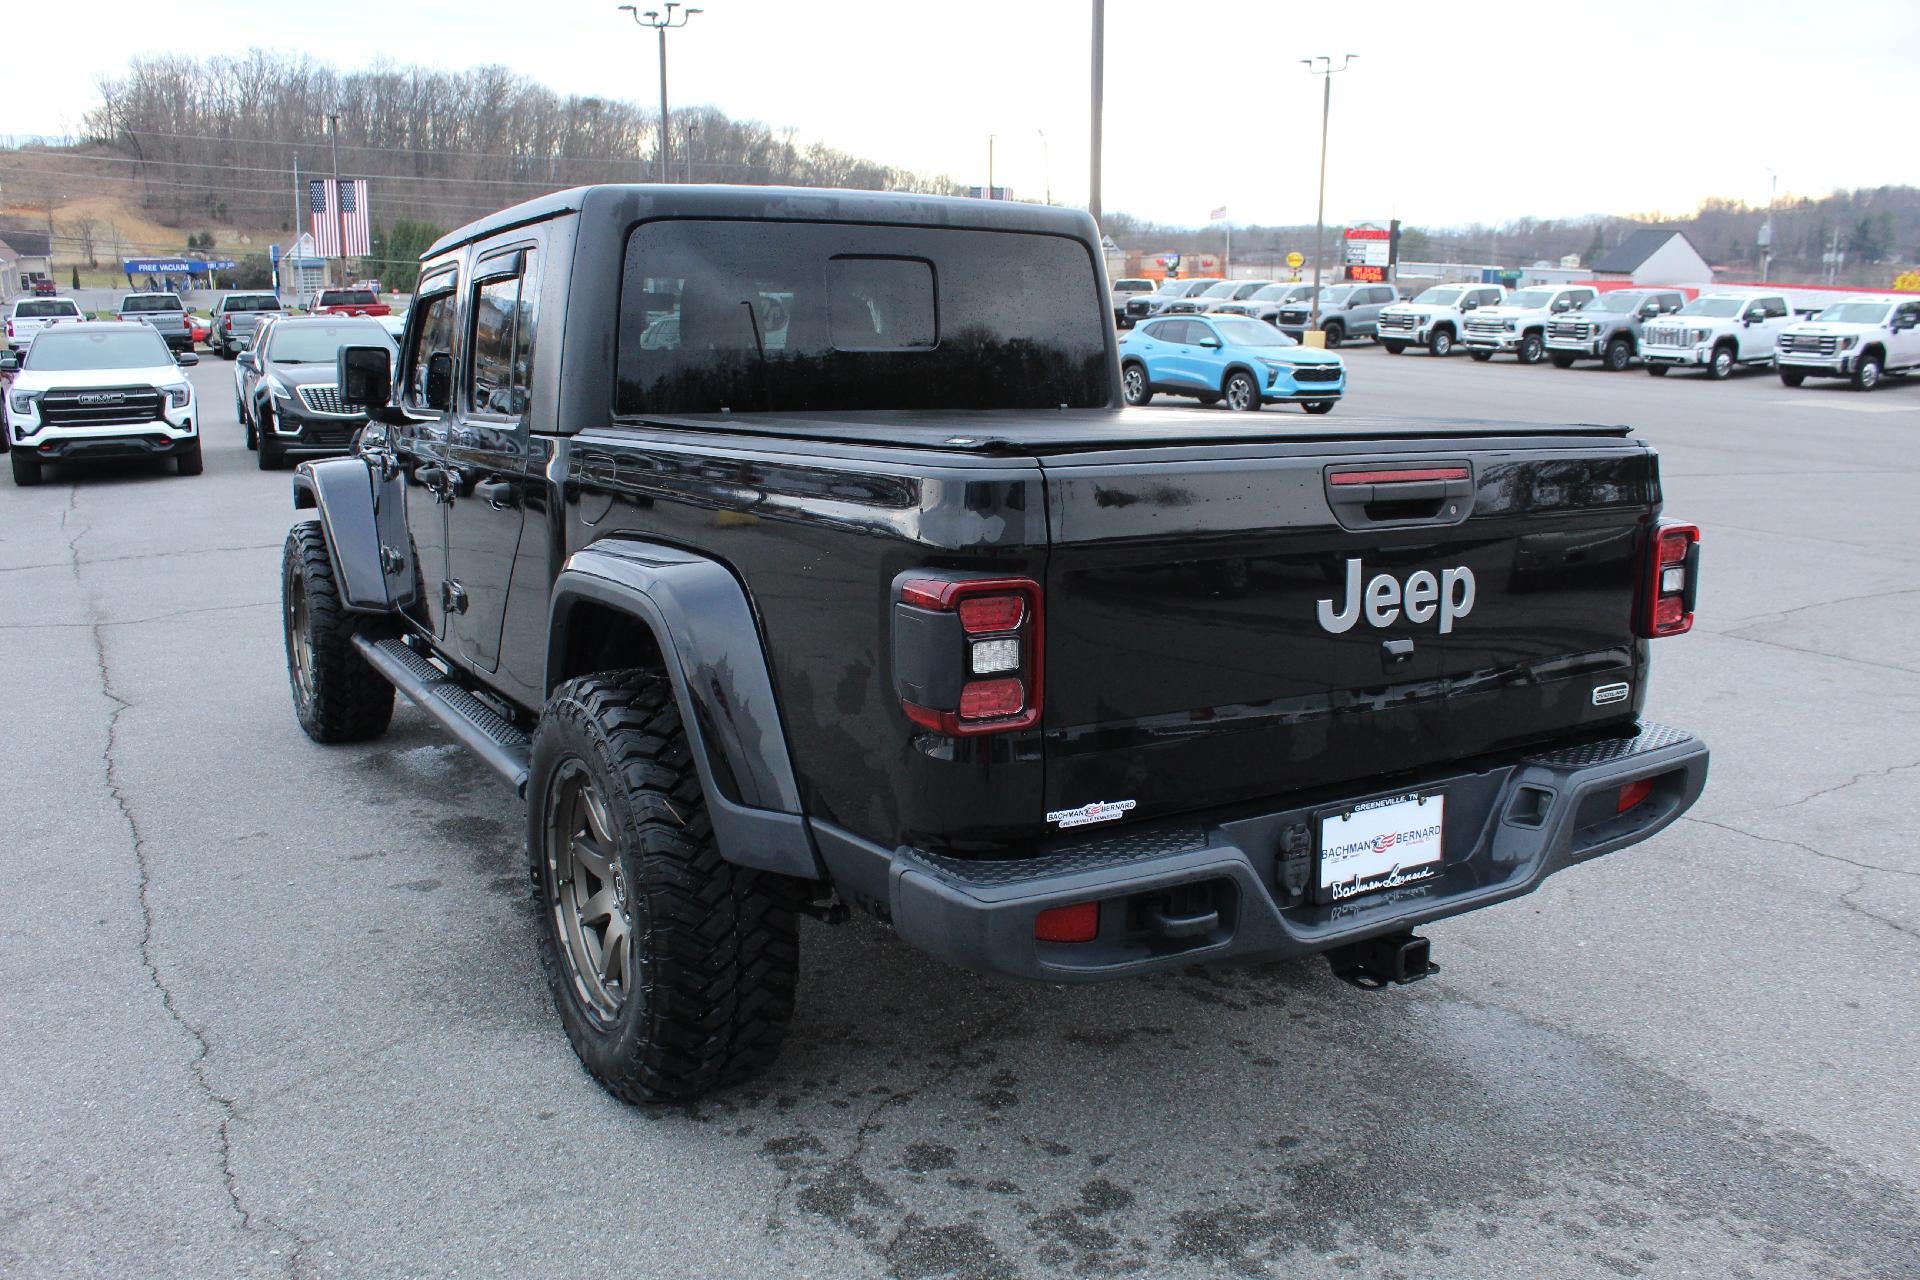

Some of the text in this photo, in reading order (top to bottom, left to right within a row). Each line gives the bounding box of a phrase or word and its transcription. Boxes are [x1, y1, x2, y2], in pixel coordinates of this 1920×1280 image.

[138, 262, 189, 272] FREE VACUUM
[1317, 558, 1476, 634] Jeep
[1048, 801, 1135, 821] BACHMAN BERNARD
[1321, 840, 1371, 860] BACHMAN
[1396, 825, 1441, 844] BERNARD
[1332, 863, 1434, 900] Bachman Bernard
